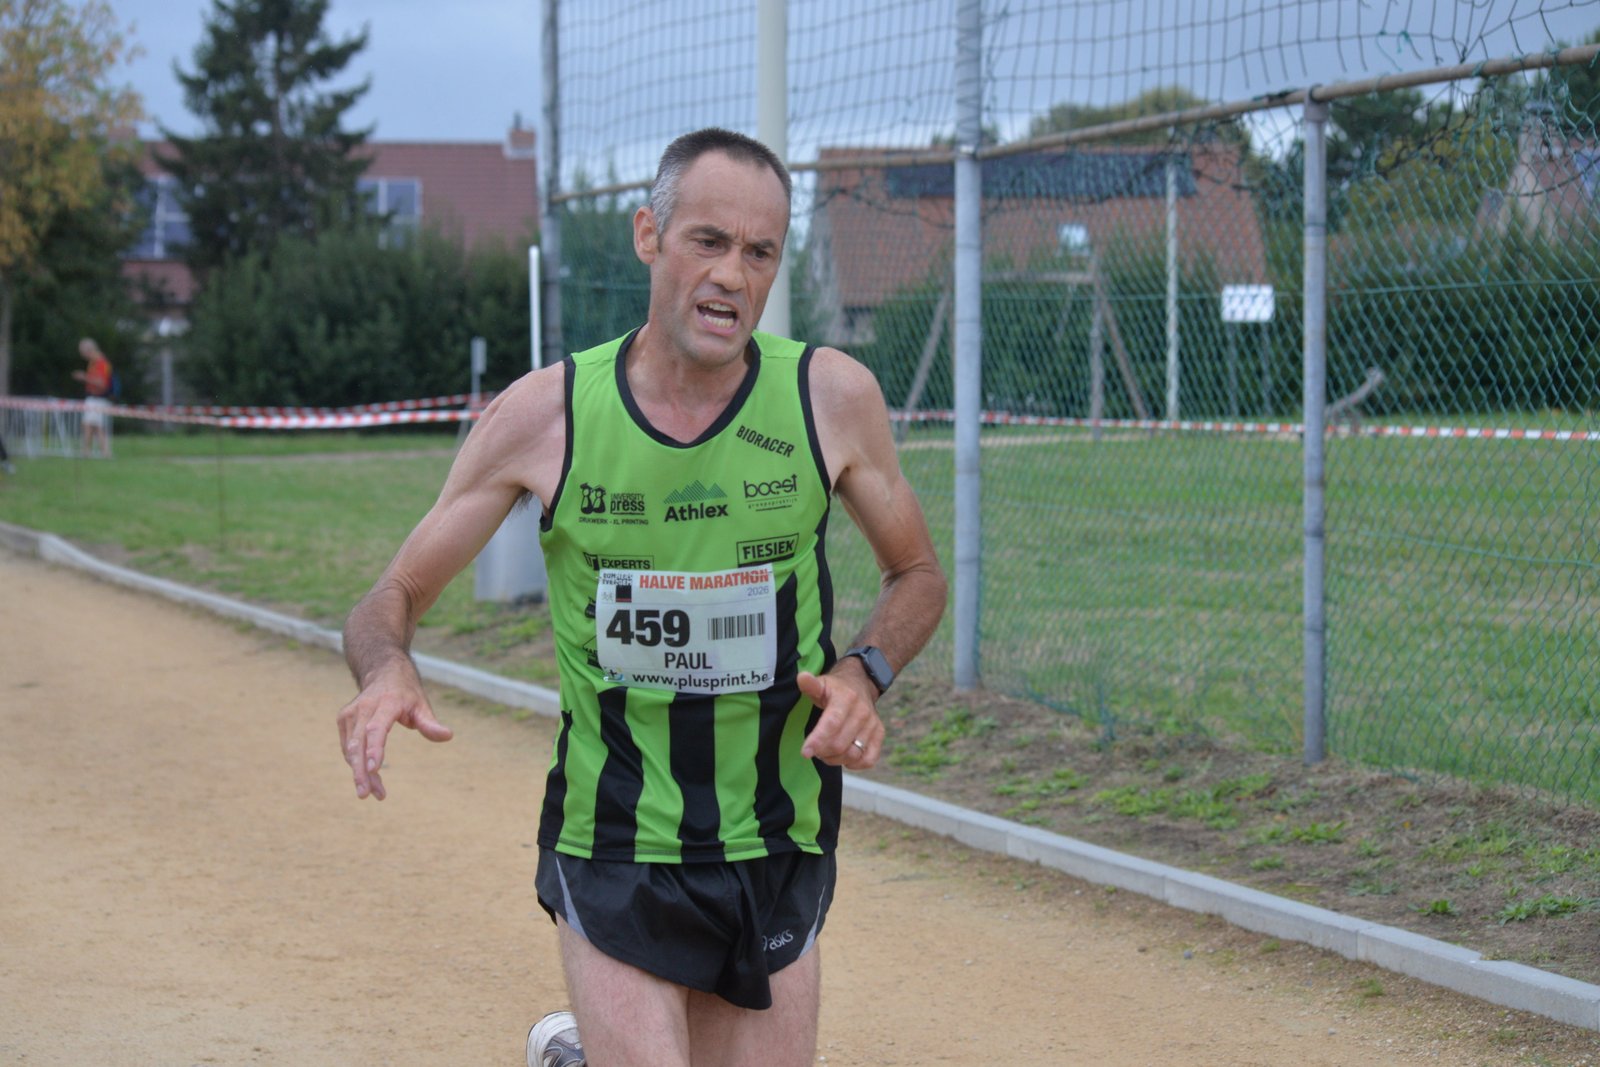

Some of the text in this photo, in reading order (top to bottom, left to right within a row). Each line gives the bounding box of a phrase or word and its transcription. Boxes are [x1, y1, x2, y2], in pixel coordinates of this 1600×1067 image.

[736, 425, 795, 458] BIORACER
[610, 499, 645, 514] press
[611, 493, 645, 501] UNIVERSITY
[664, 502, 728, 522] Athlex
[743, 539, 794, 560] FIESIEK
[601, 559, 651, 570] EXPERTS
[639, 575, 685, 589] HALVE
[690, 569, 769, 590] MARATHON
[747, 586, 769, 596] 2026
[606, 610, 690, 647] 459
[664, 652, 713, 669] PAUL
[632, 671, 769, 690] www.plusprint.be
[769, 929, 794, 950] asics
